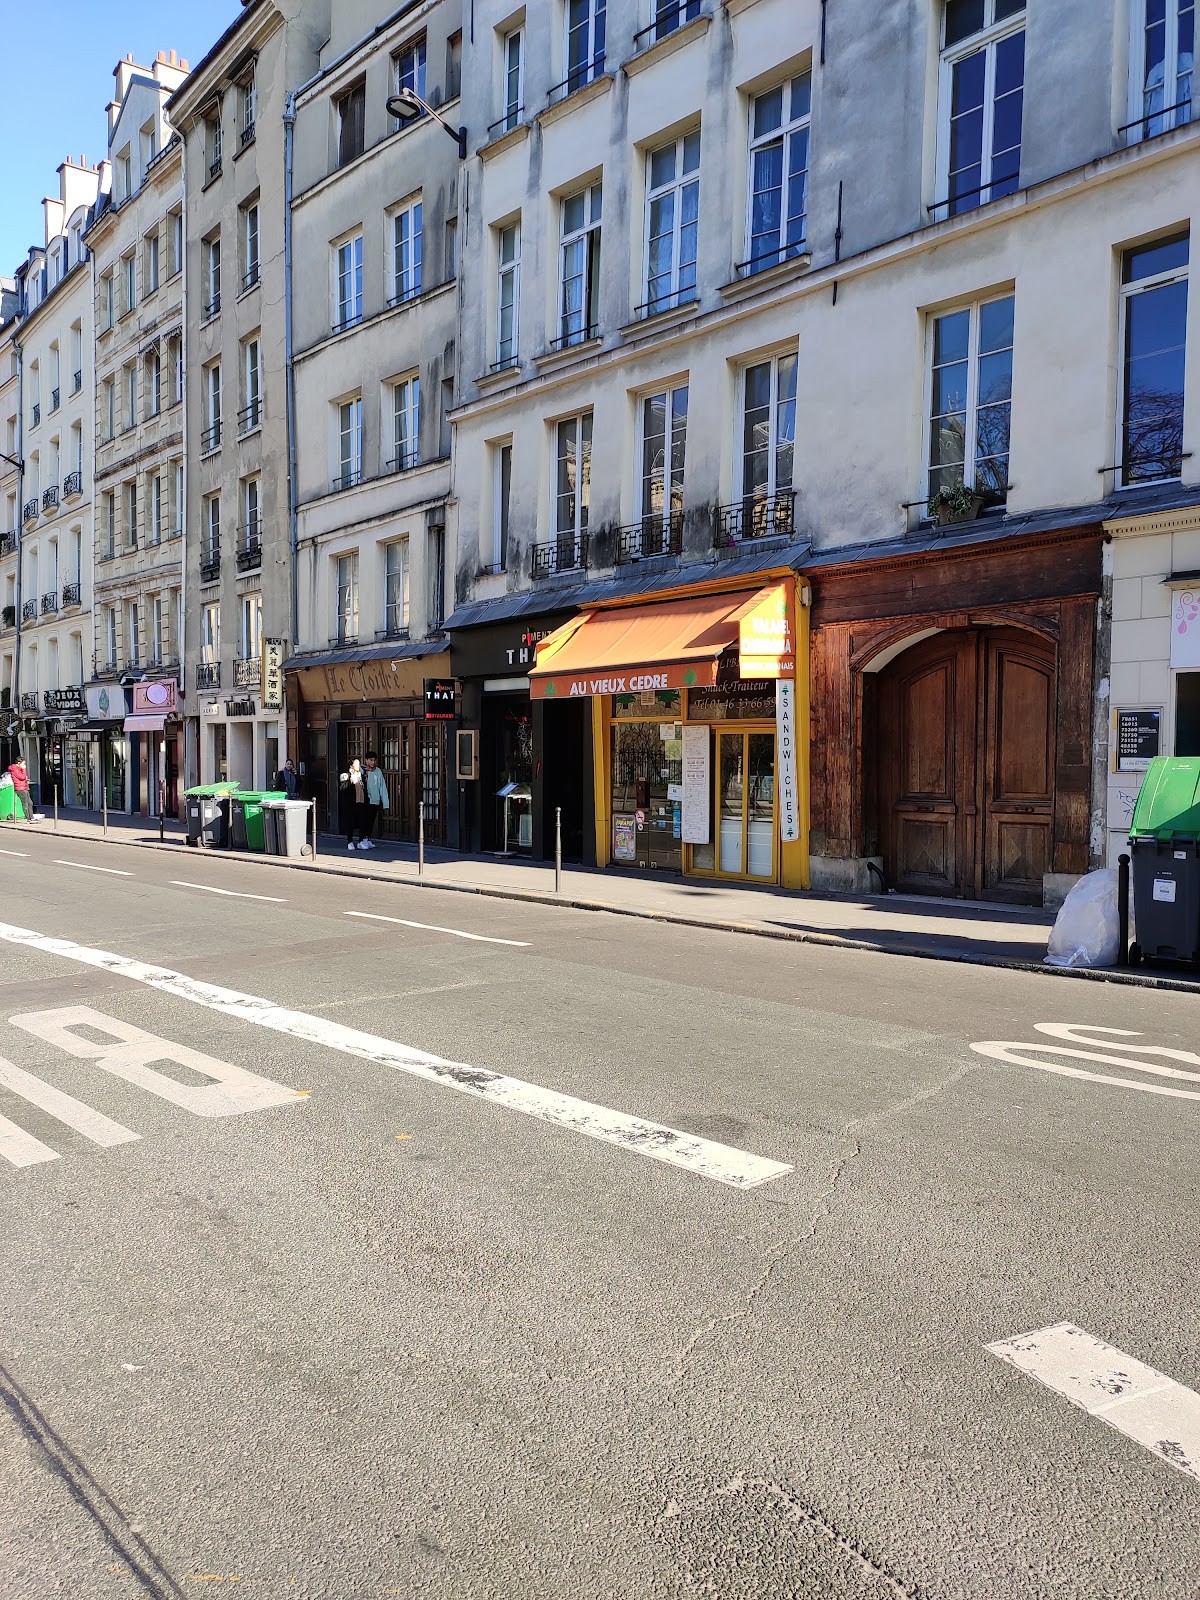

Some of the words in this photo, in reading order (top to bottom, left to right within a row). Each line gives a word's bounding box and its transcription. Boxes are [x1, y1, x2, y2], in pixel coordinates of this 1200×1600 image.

[569, 681, 587, 696] AU
[589, 677, 627, 694] VIEUX
[629, 673, 668, 691] CEDRE
[56, 690, 80, 700] JEUX
[56, 700, 81, 709] VIDEO
[781, 698, 795, 824] SANDWICHES
